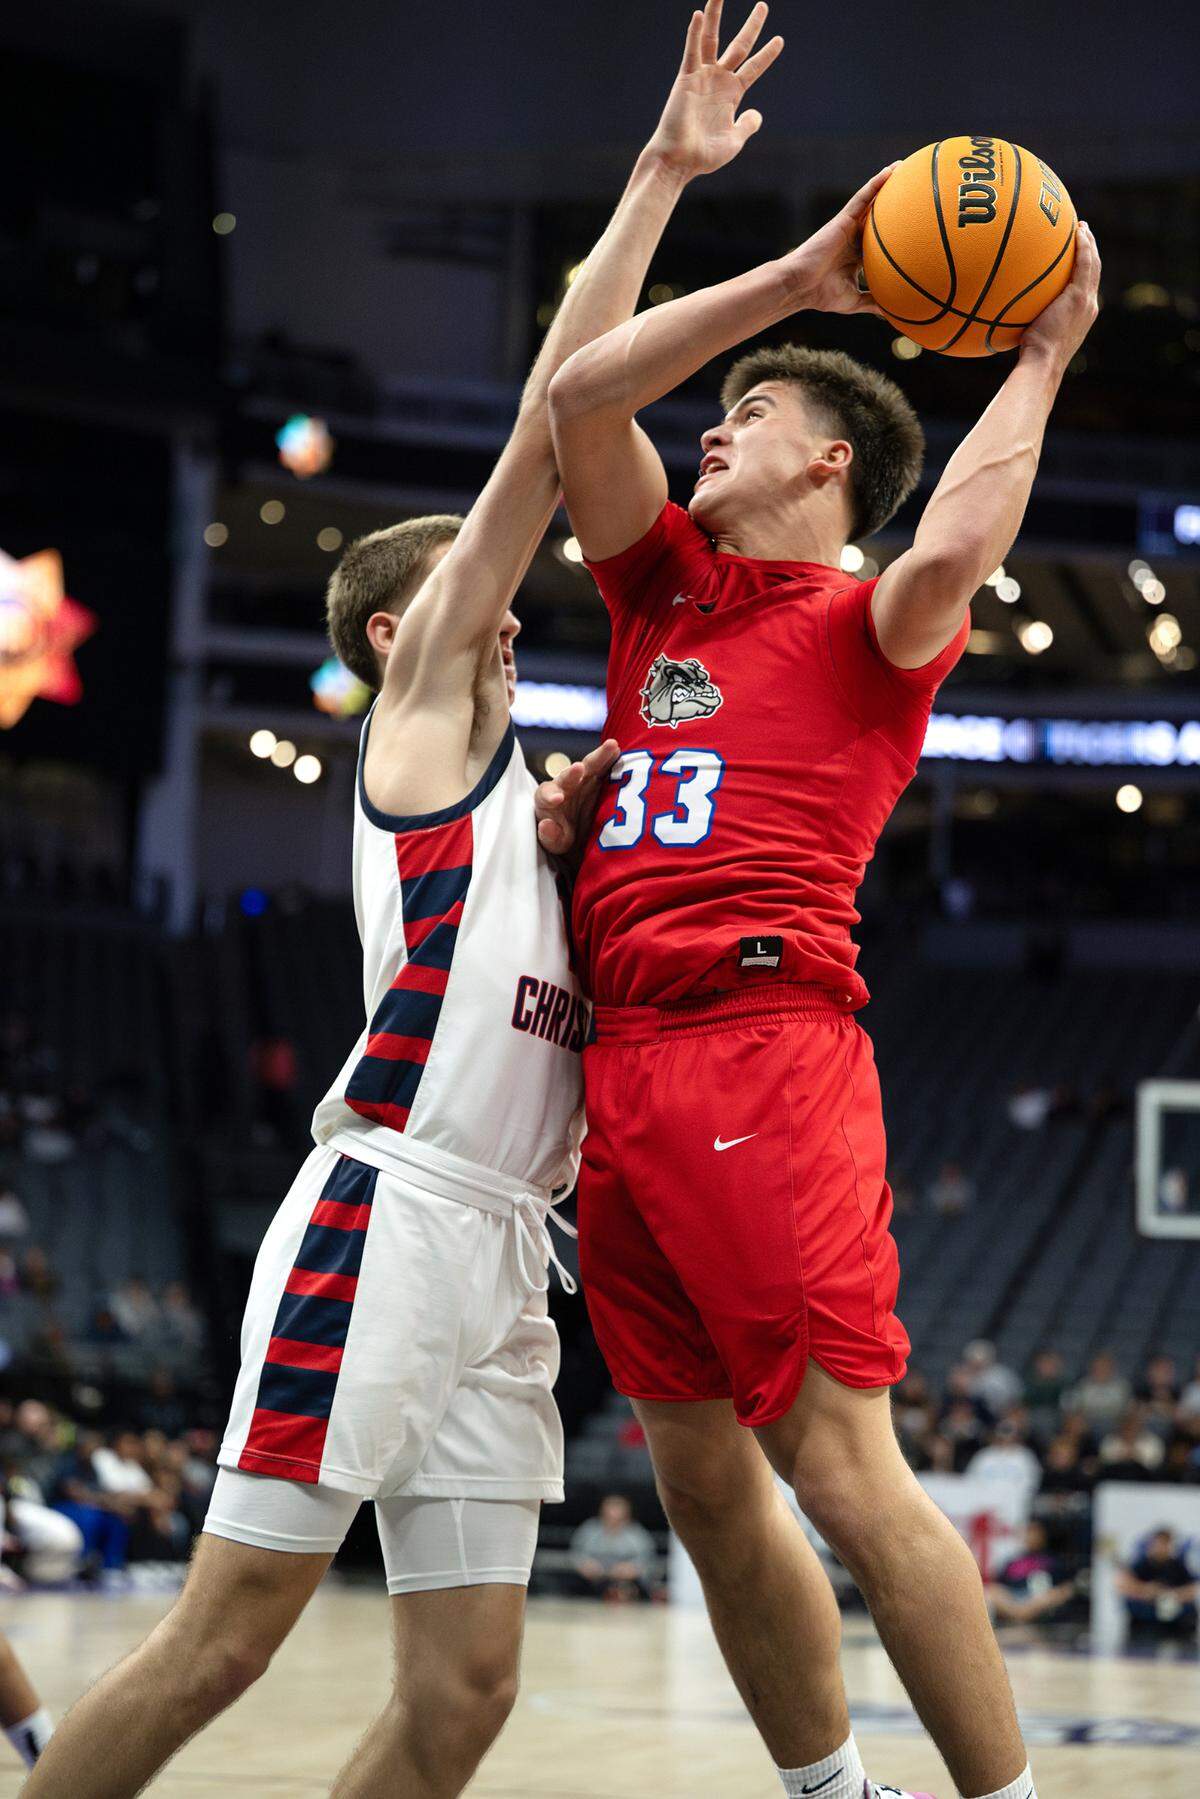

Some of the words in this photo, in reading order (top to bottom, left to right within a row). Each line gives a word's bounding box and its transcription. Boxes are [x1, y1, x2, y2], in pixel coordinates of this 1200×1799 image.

[598, 748, 727, 851] 33
[757, 941, 767, 954] L
[511, 974, 590, 1054] CHRIS
